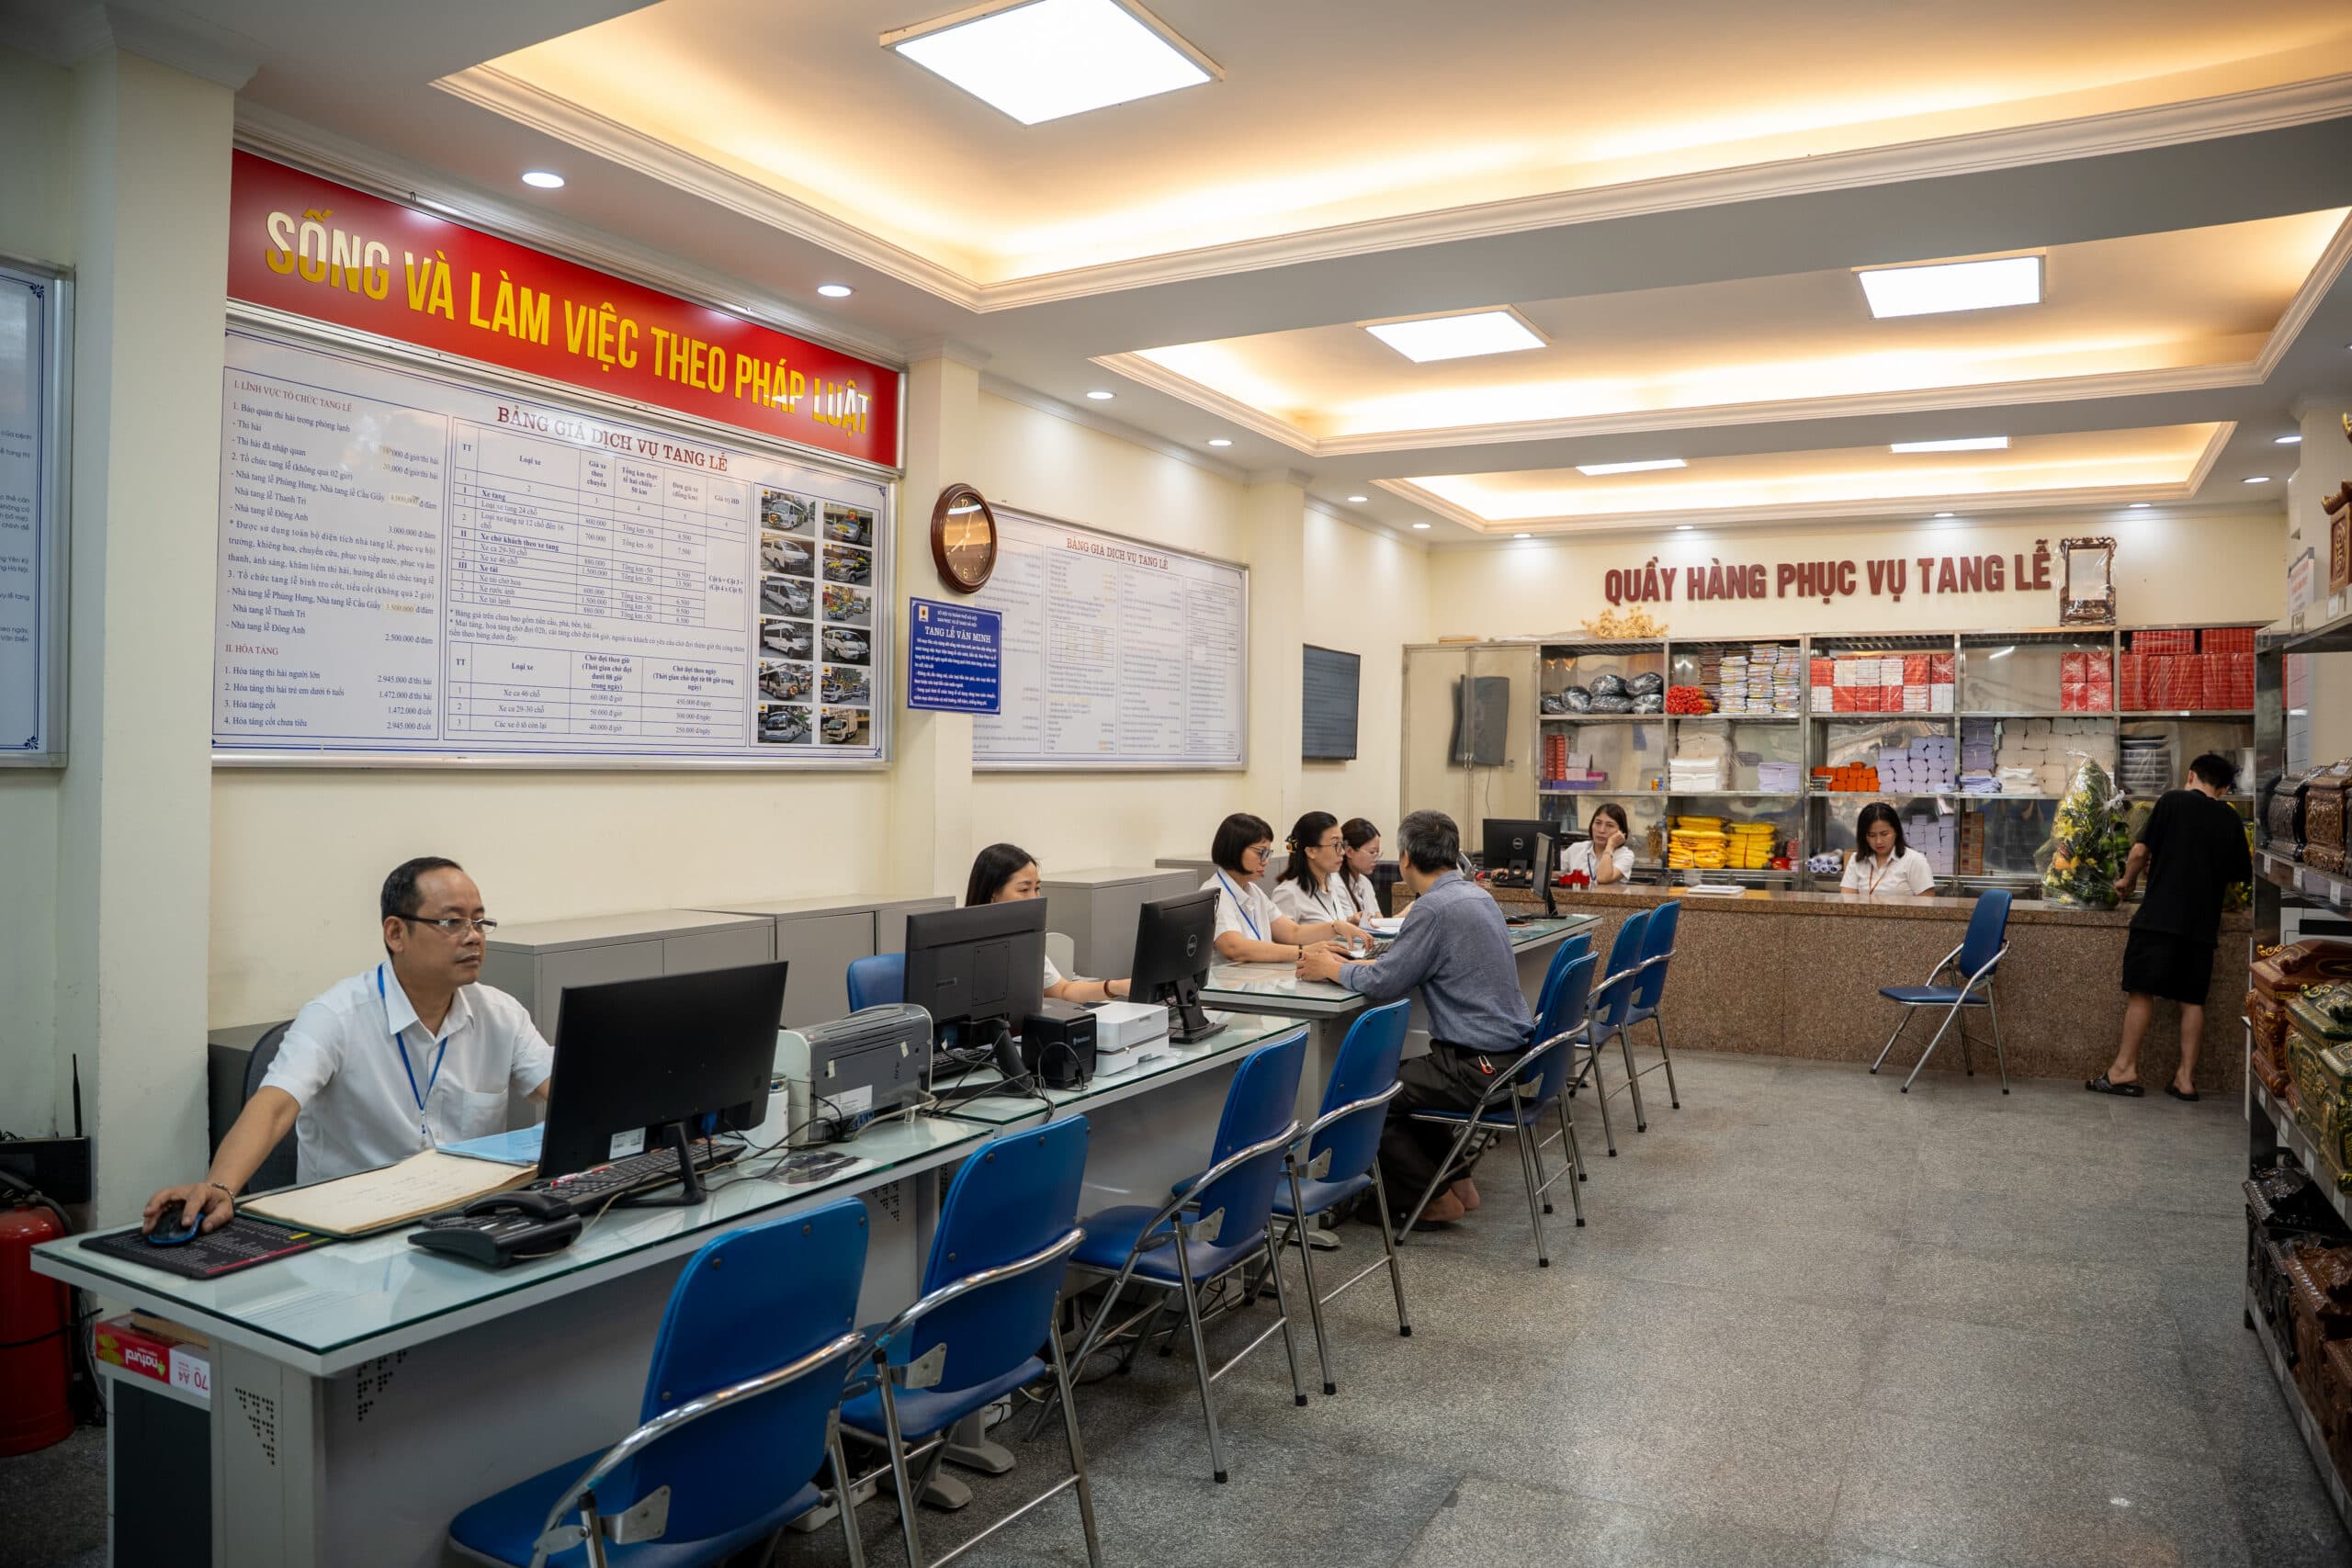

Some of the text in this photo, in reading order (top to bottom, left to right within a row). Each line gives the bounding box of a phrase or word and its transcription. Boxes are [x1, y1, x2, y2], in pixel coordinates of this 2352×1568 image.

[266, 208, 872, 437] SỐNG VÀ LÀM VIỆC THEO PHÁP LUẬT
[320, 399, 341, 411] TANG
[497, 405, 729, 472] BẢNG GIÁ DỊCH VỤ TANG LỄ
[268, 460, 283, 470] tang
[252, 473, 266, 484] tang
[334, 486, 348, 497] tang
[251, 490, 265, 500] tang
[275, 492, 295, 503] Thanh
[251, 506, 265, 517] tang
[294, 513, 308, 522] Anh
[1067, 536, 1089, 552] BẢNG
[1106, 547, 1125, 560] DỊCH
[1139, 554, 1158, 568] TANG
[1604, 538, 2052, 605] QUẦY HÀNG PHỤC VỤ TANG LỄ
[248, 590, 263, 600] tang
[331, 597, 345, 607] tang
[249, 606, 264, 616] tang
[274, 608, 294, 617] Thanh
[247, 623, 262, 633] tang
[291, 626, 305, 635] Anh
[925, 626, 991, 643] TANG LỄ VĂN MINH
[125, 1348, 158, 1368] natural
[178, 1371, 190, 1384] A4
[194, 1371, 209, 1391] 70
